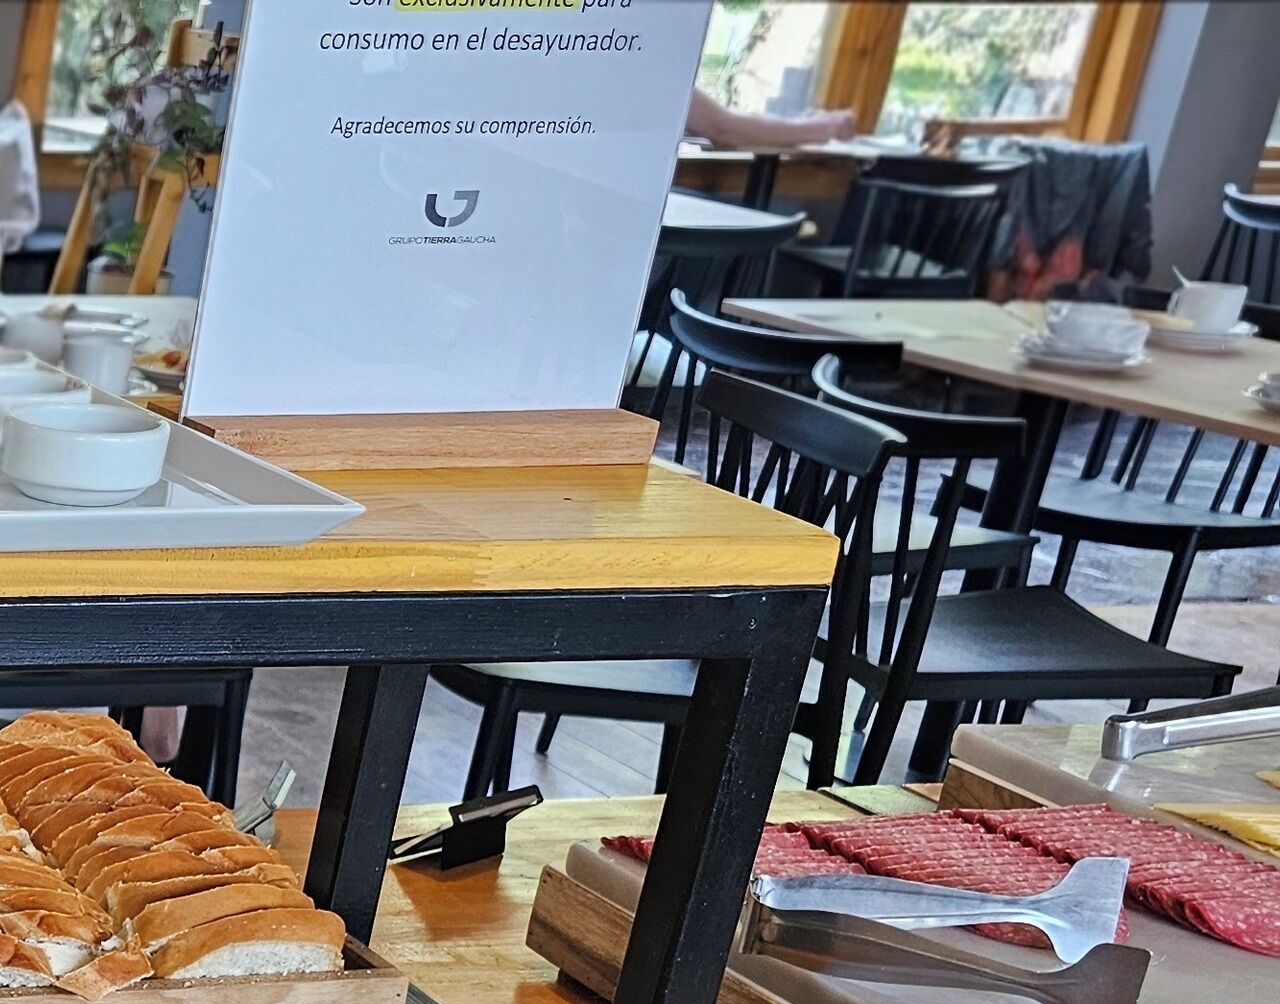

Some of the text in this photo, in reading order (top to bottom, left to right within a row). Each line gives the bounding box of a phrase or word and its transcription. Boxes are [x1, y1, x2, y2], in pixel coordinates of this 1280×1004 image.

[320, 27, 642, 55] consumo en el desayunador.
[331, 116, 596, 138] Agradecemos su comprensión.
